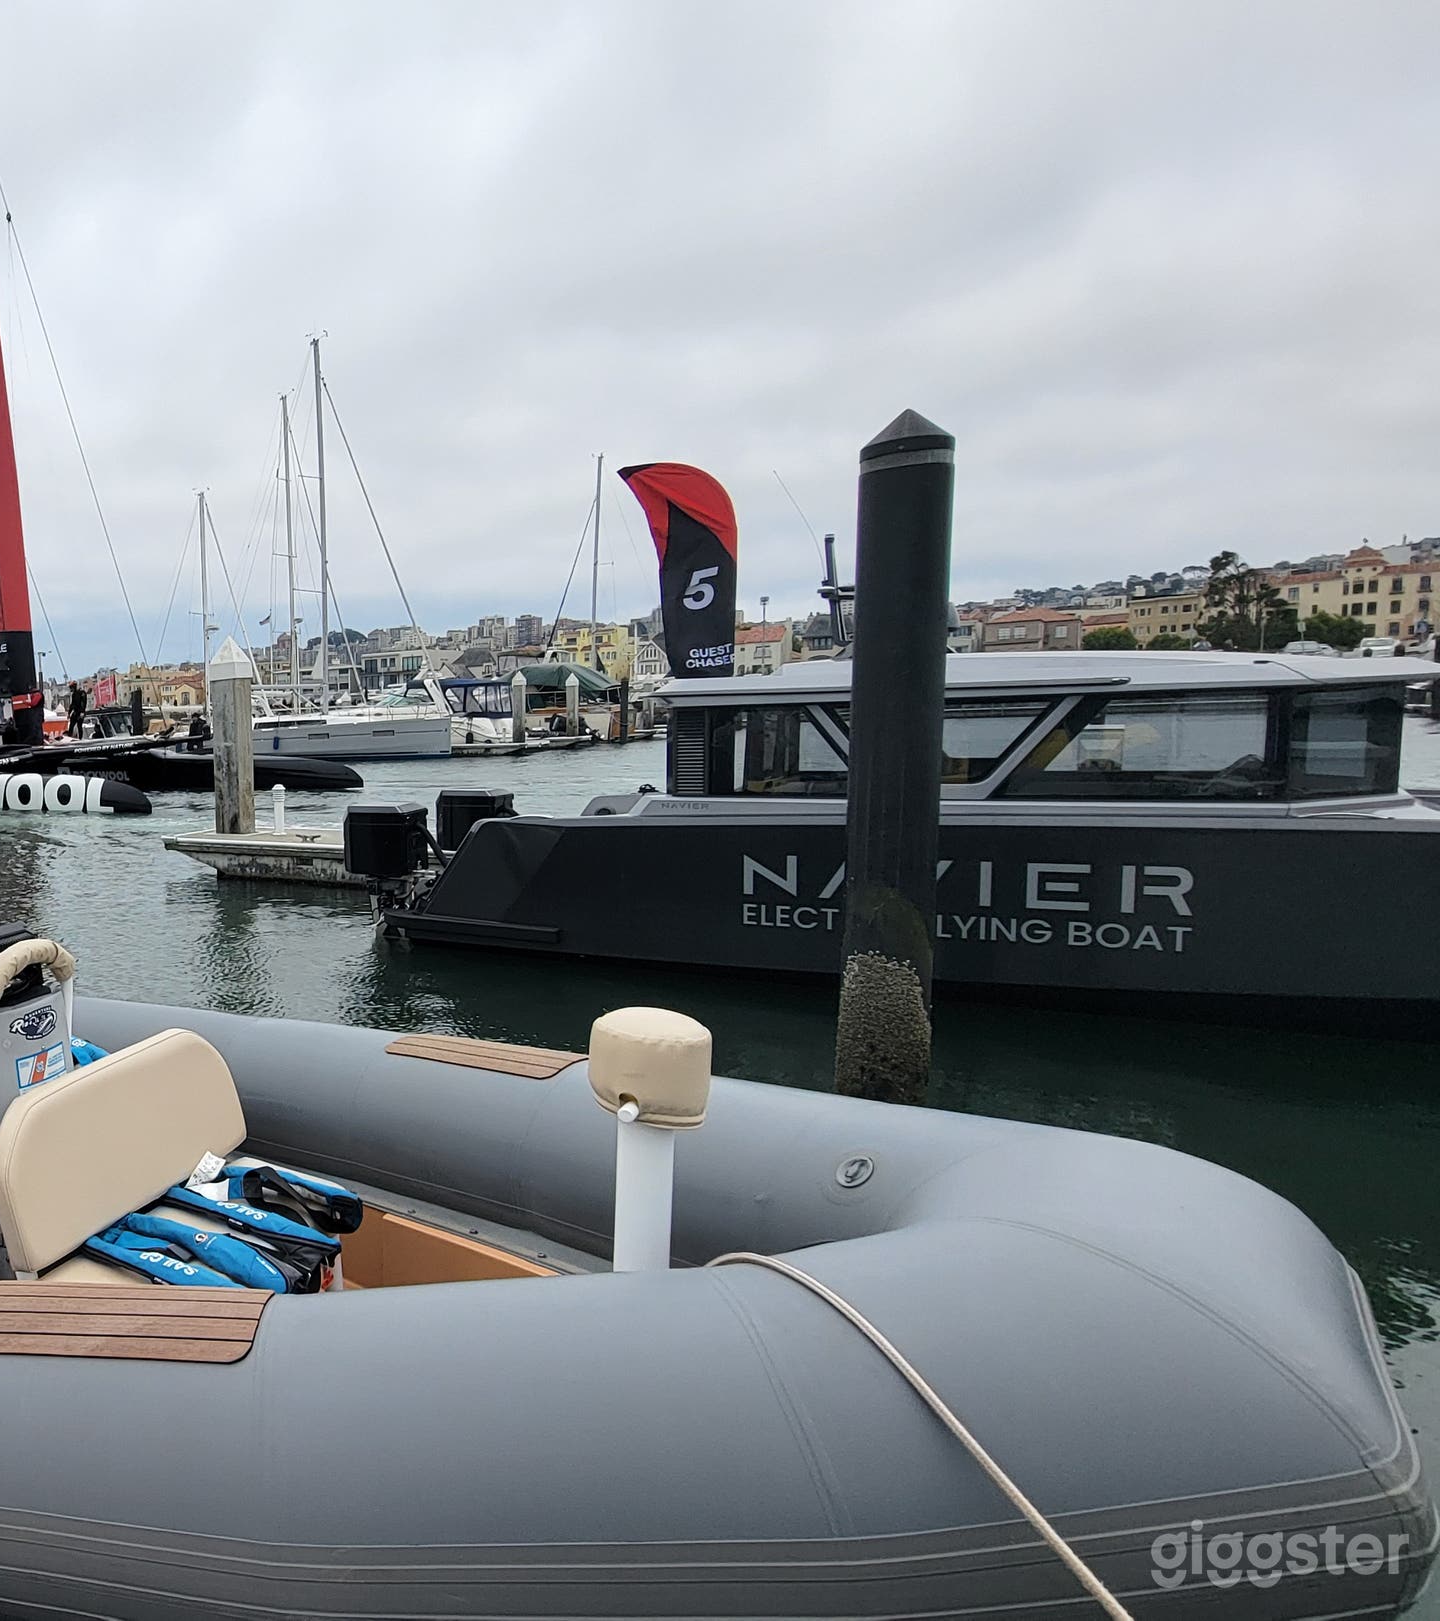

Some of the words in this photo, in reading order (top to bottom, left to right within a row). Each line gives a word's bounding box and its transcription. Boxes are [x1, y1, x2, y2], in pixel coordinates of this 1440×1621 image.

[682, 566, 719, 610] 5
[689, 643, 732, 658] GUEST
[661, 802, 710, 810] NAVIER
[743, 854, 1194, 916] NIER
[743, 903, 840, 930] ELECT
[936, 914, 1053, 943] LYING
[1067, 921, 1193, 952] BOAT
